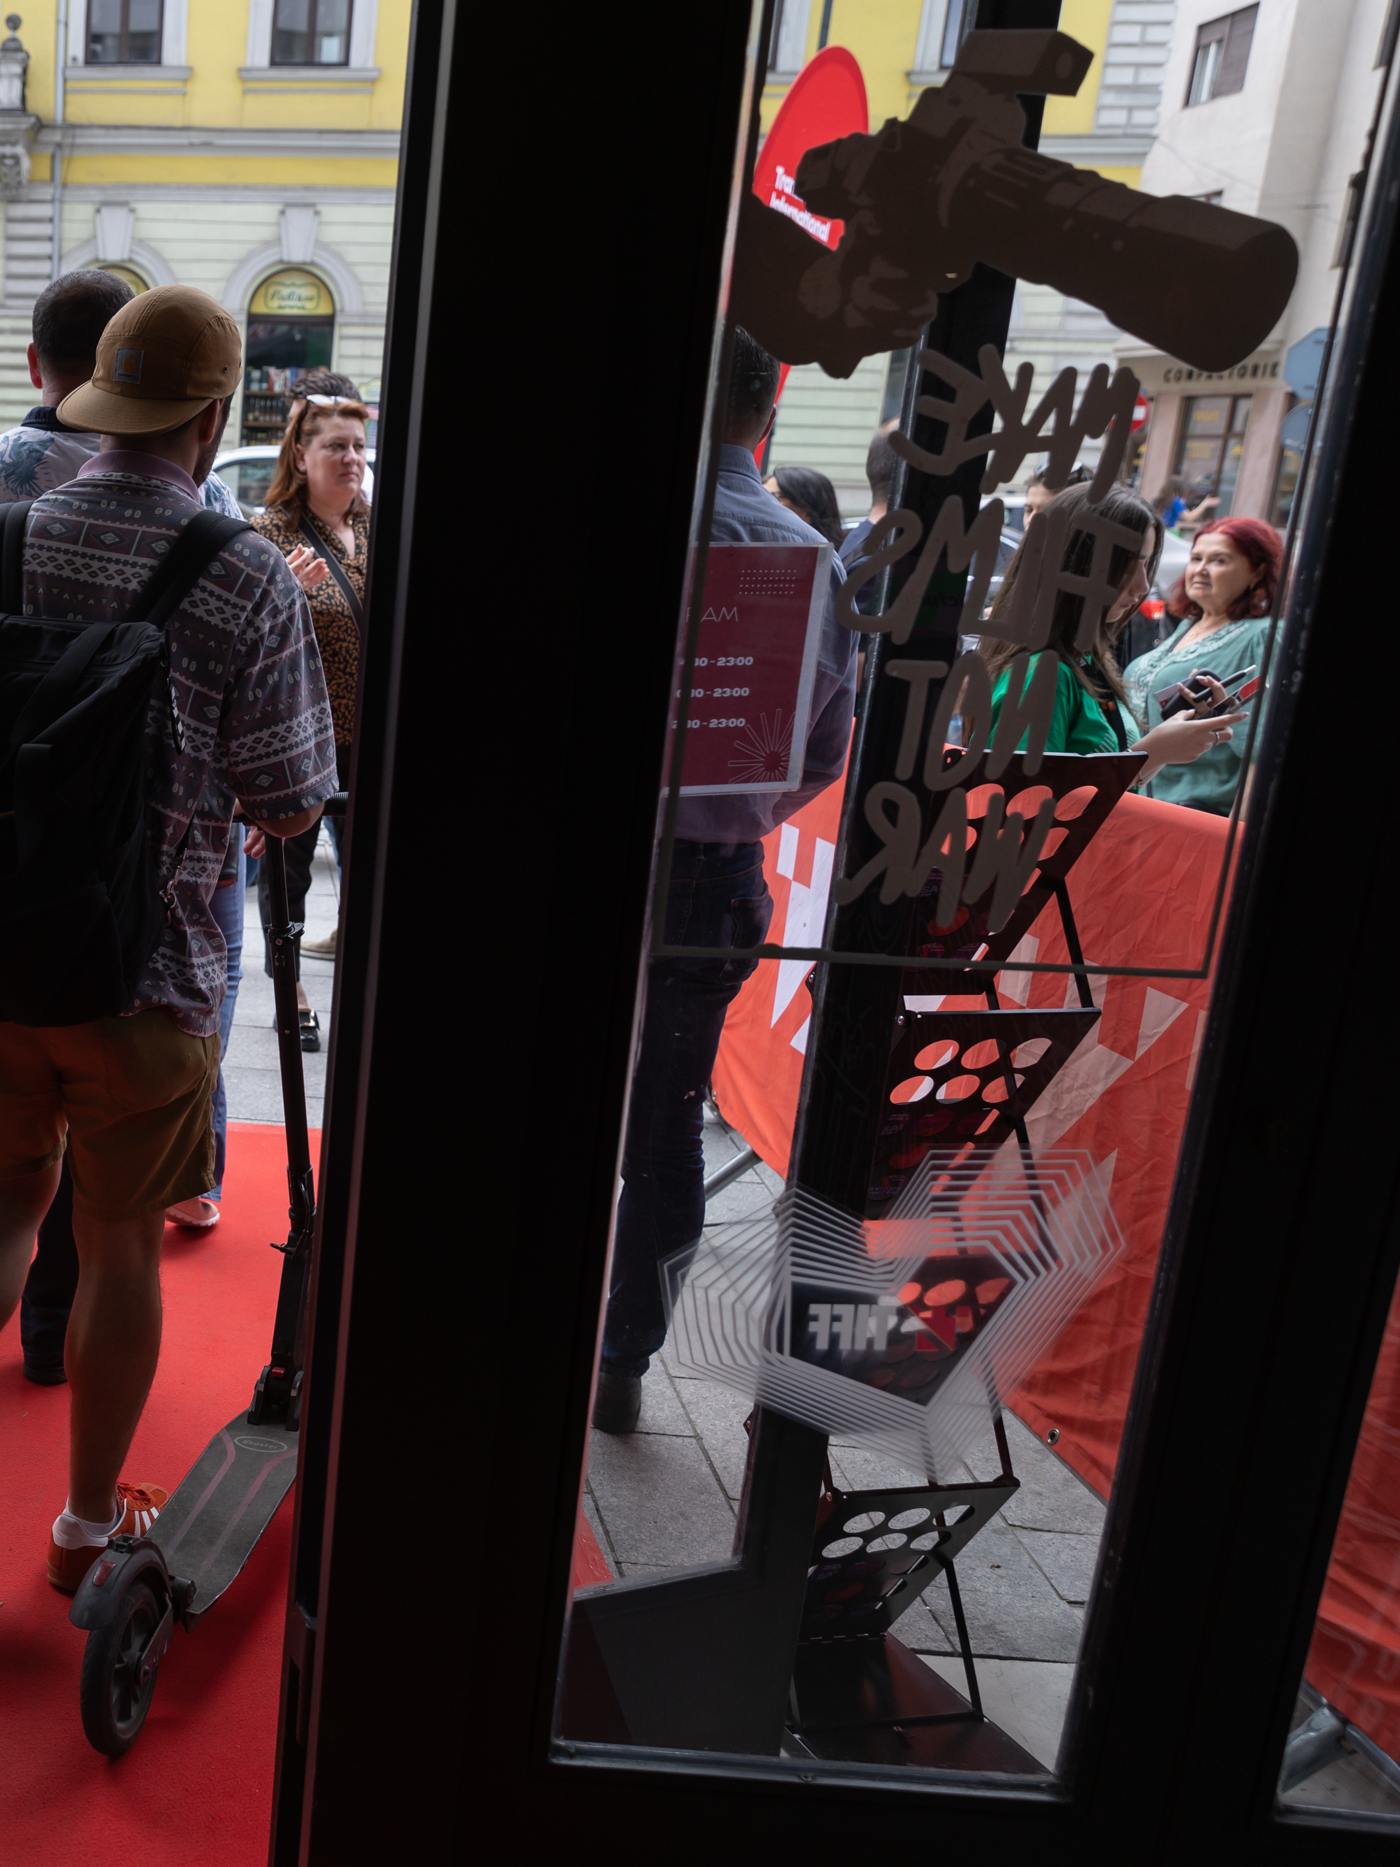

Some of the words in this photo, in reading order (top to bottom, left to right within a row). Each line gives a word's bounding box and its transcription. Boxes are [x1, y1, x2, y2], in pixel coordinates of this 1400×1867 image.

[769, 191, 832, 243] International
[716, 656, 754, 666] 23:00
[712, 687, 750, 697] 23:00
[708, 718, 746, 728] 23:00
